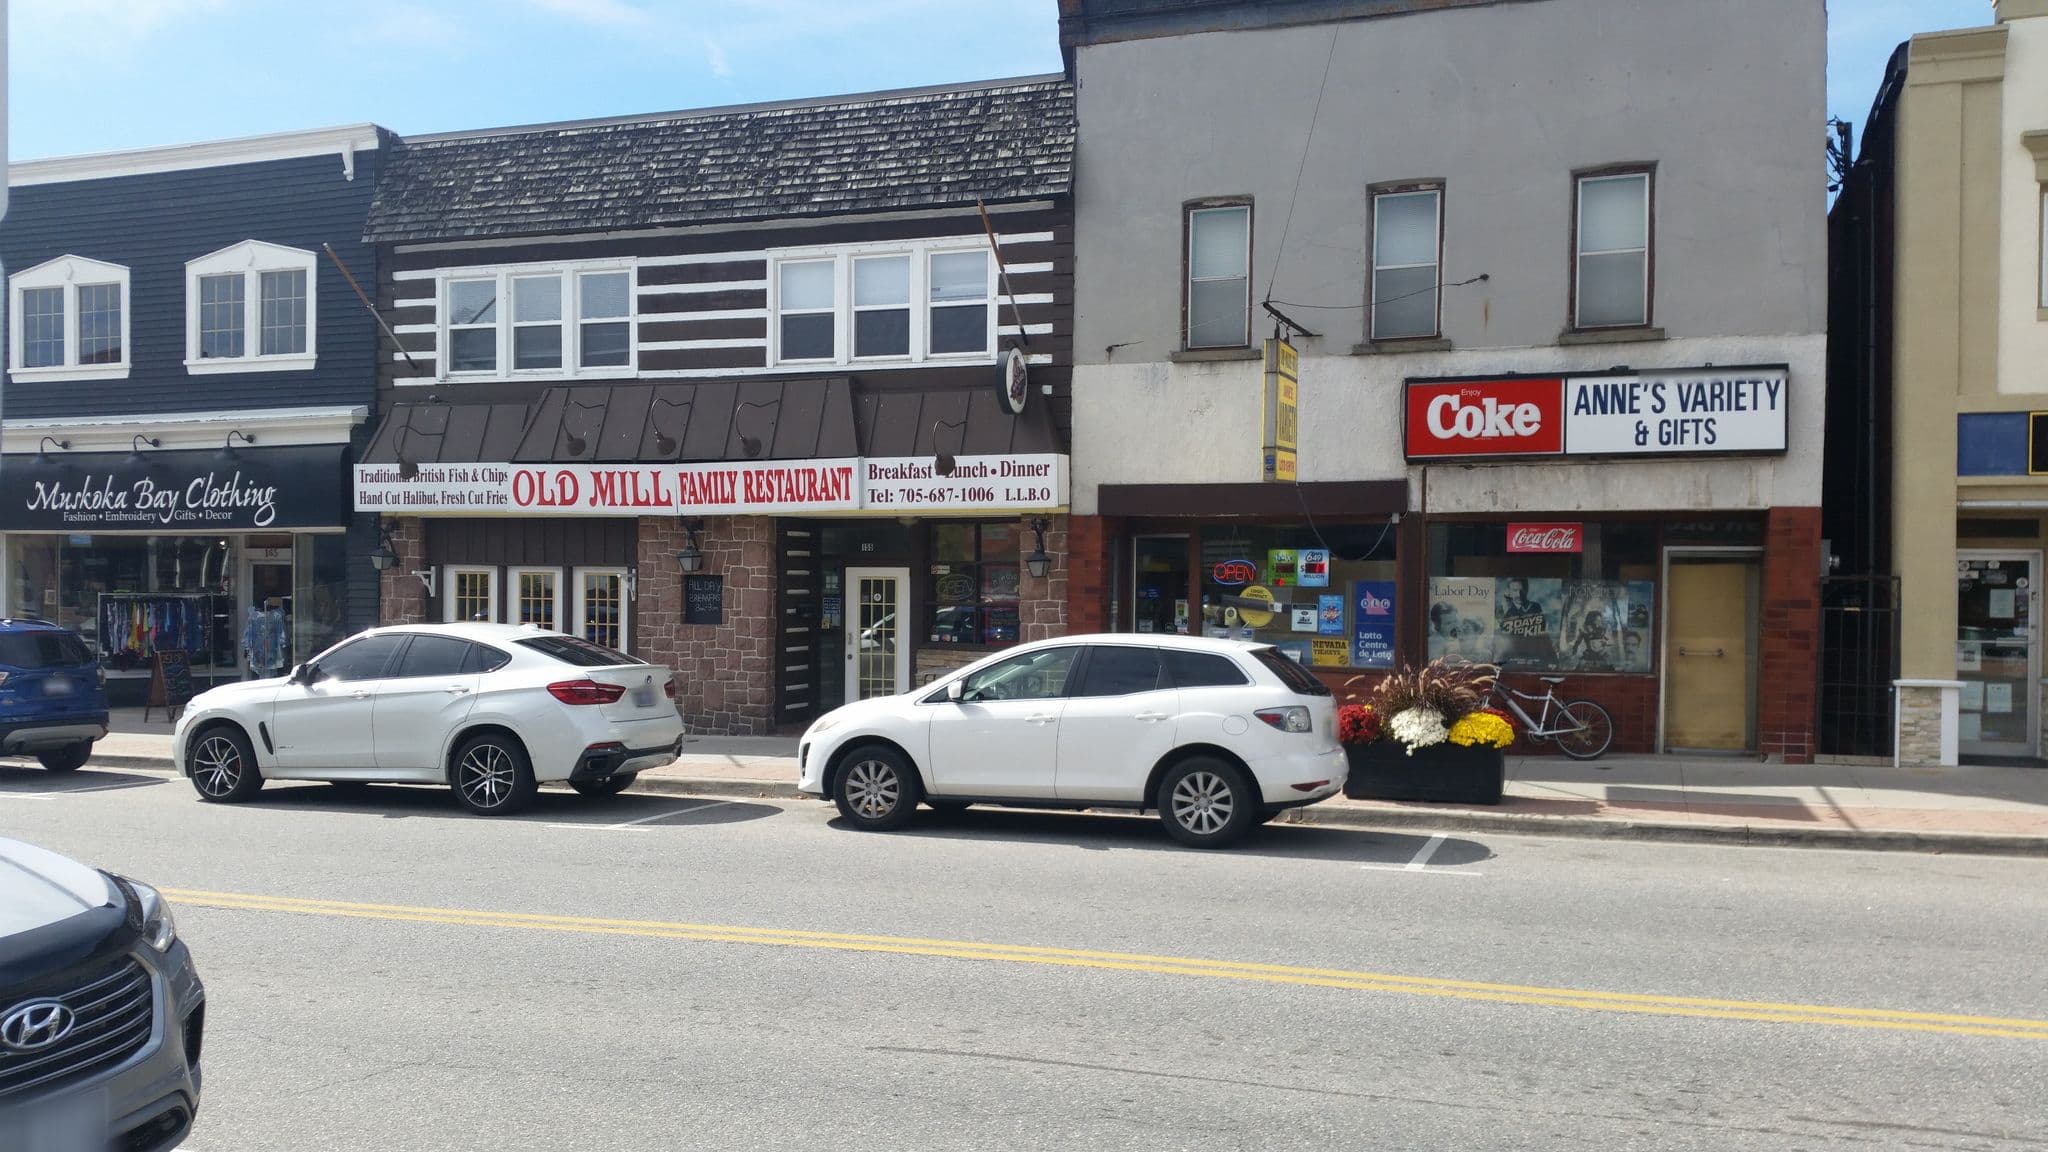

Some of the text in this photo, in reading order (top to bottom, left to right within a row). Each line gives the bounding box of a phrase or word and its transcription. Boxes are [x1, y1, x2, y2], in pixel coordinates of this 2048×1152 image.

[1461, 388, 1481, 397] Enjoy
[1574, 379, 1781, 415] ANNE'S VARIETY
[1427, 394, 1541, 439] Coke
[1635, 418, 1717, 446] & GIFTS
[449, 468, 469, 483] Fish
[471, 469, 479, 482] &
[481, 468, 508, 486] Chips
[868, 463, 932, 480] Breakfast
[1000, 460, 1050, 477] Dinner
[512, 467, 853, 507] OLD MILL FAMILY RESTAURANT
[868, 487, 1050, 503] Tel: 705-687-1006 L.L.B.O
[26, 470, 278, 527] Muskoka Bay Clothing
[359, 490, 508, 506] Hand Cut Halibut, Fresh Cut Fries
[63, 509, 233, 524] Fashion Embroidery Gifts Decor
[1512, 528, 1577, 549] Coca-Cola
[1213, 563, 1256, 581] OPEN
[1435, 585, 1490, 598] Labor Day
[1361, 598, 1390, 609] OLG
[1503, 620, 1513, 634] 3
[1513, 615, 1543, 628] DAYS
[1313, 640, 1347, 649] NEVADA
[1359, 632, 1382, 640] Lotto
[1359, 641, 1388, 649] Centre
[1372, 651, 1392, 659] Loto
